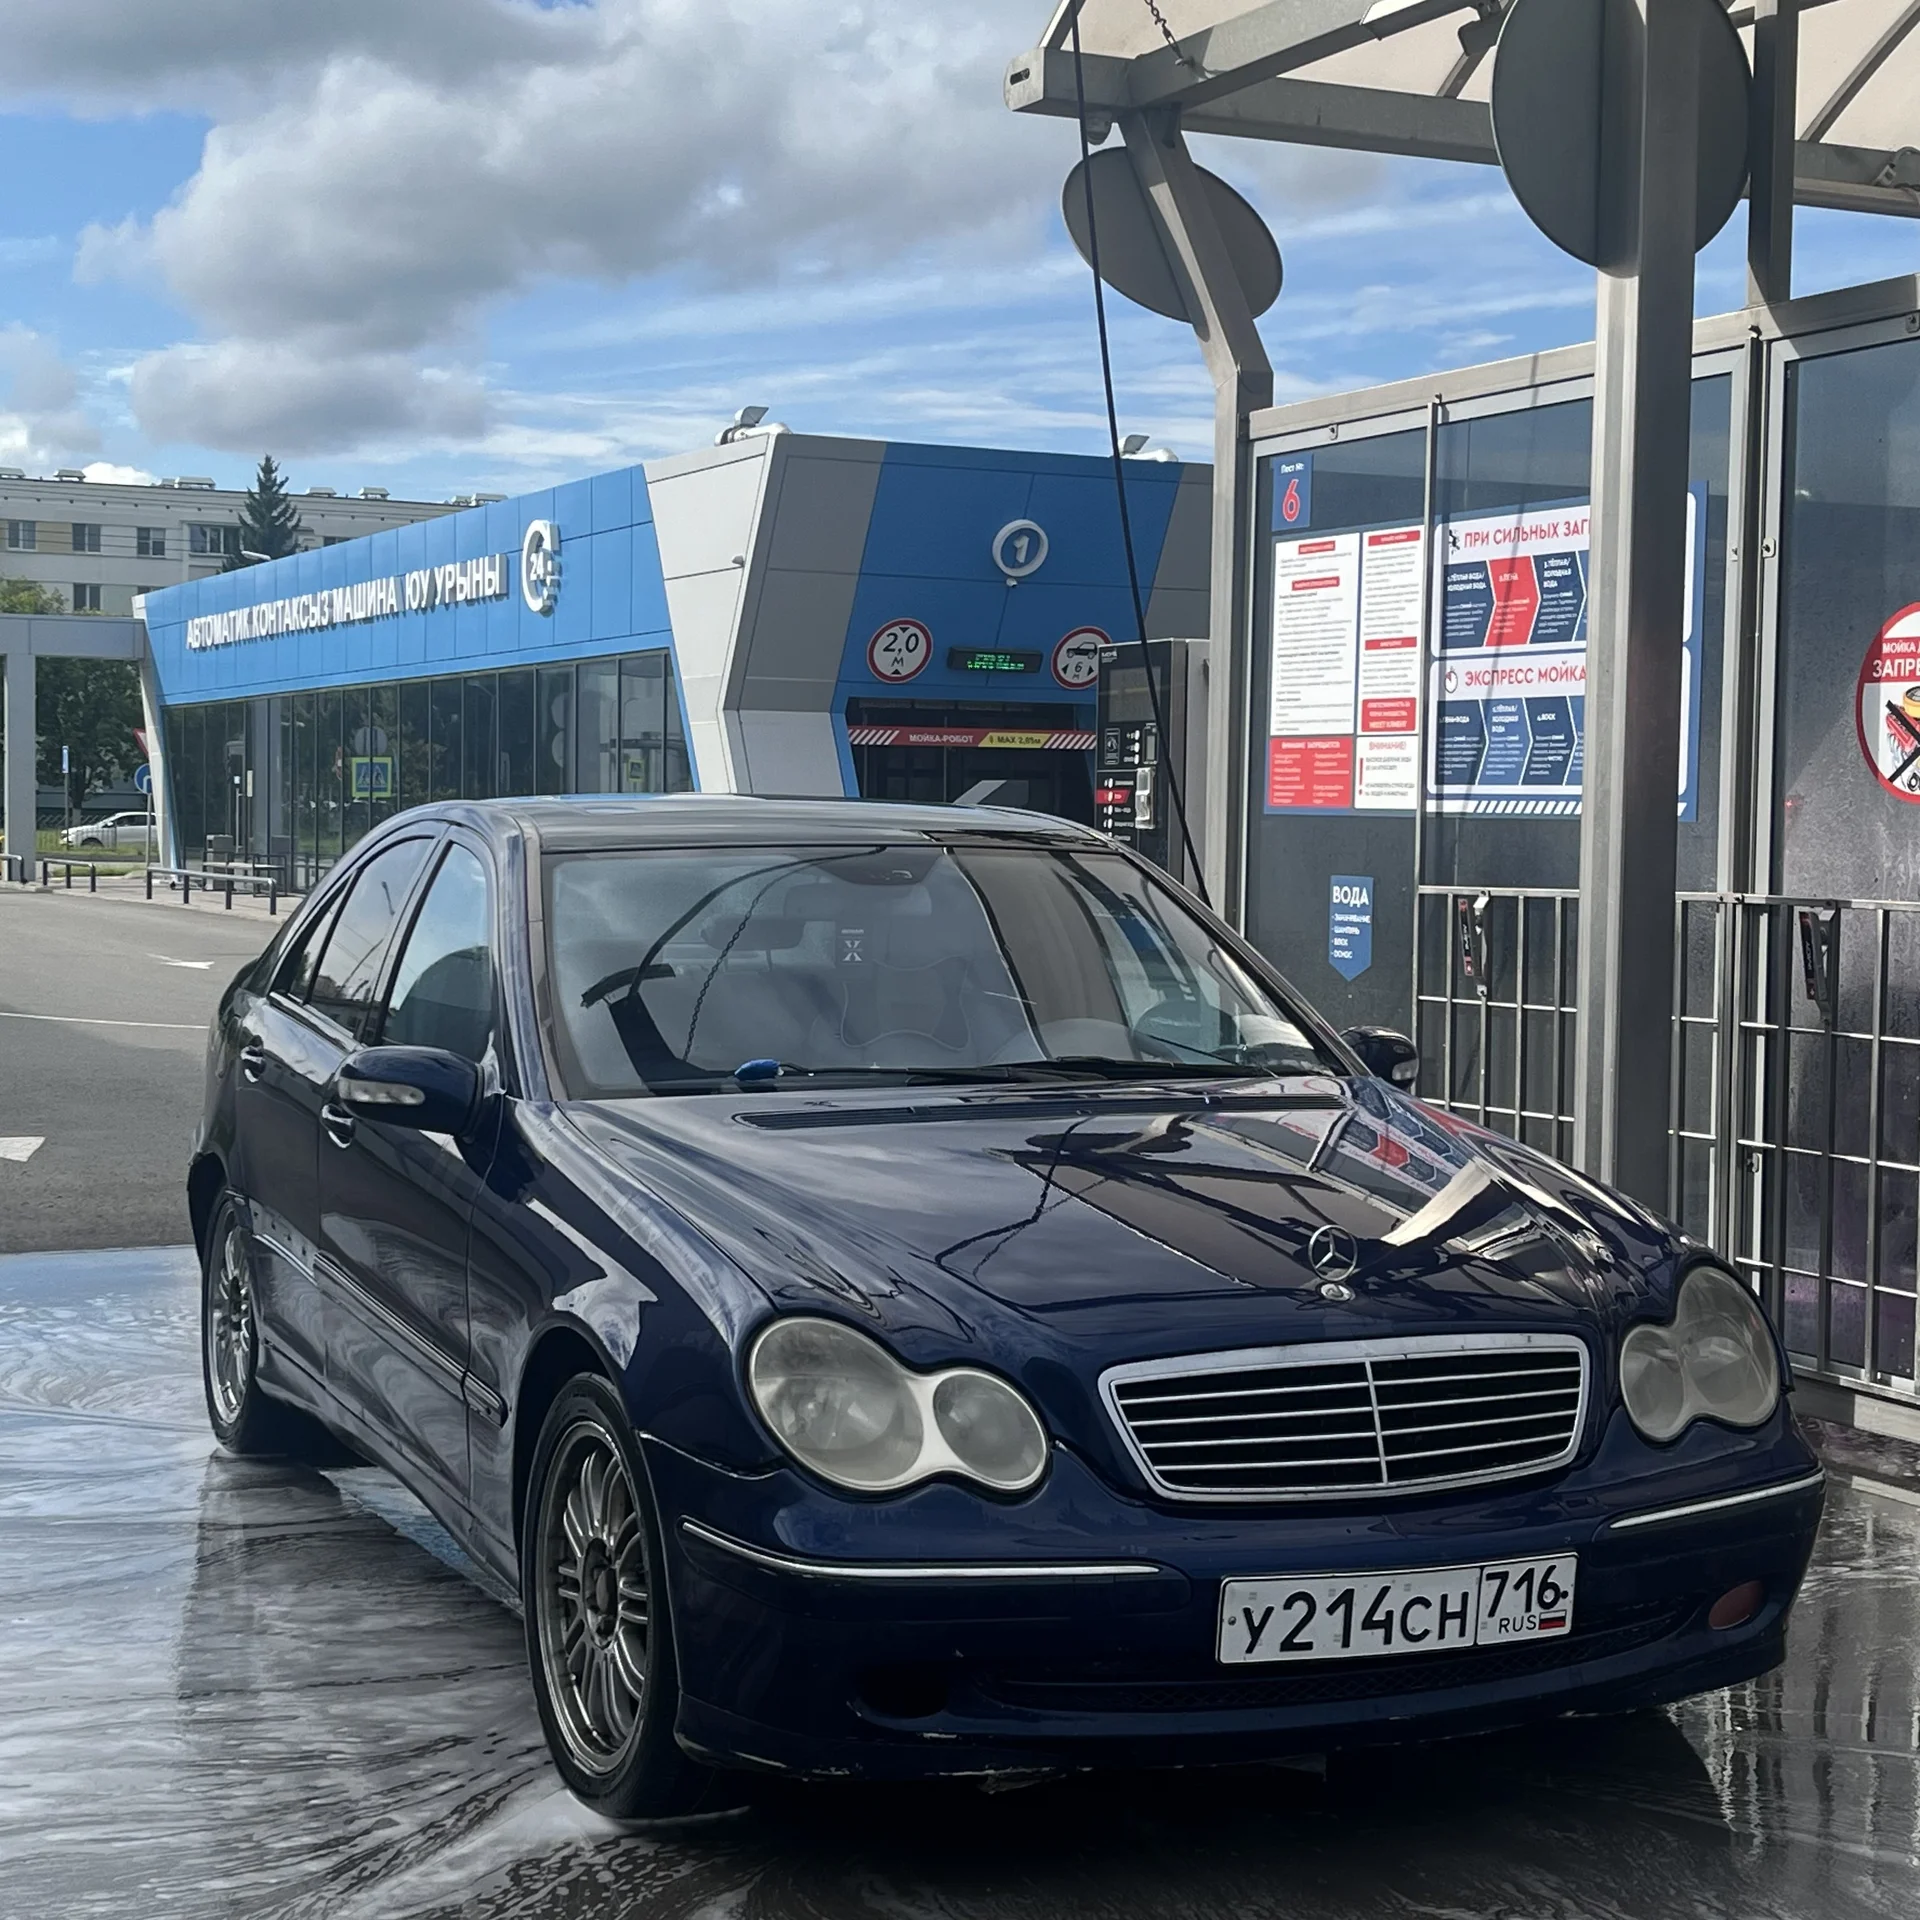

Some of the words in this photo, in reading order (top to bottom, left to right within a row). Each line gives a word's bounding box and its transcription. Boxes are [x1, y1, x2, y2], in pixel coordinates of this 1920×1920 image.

[1282, 478, 1300, 522] 6
[1464, 530, 1490, 548] ПРИ
[1493, 521, 1560, 546] СИЛЬНЫХ
[1563, 518, 1591, 537] ЗАГ
[1013, 535, 1030, 563] 1
[529, 552, 544, 581] 24
[186, 608, 250, 649] АВТОМАТИК
[251, 591, 329, 638] КОНТАКСЫЗ
[332, 576, 398, 623] МАШИНА
[405, 569, 431, 610] ЮУ
[434, 553, 501, 605] УРЫНЫ
[882, 633, 920, 655] 2,0
[1882, 639, 1917, 654] МОЙКА
[1073, 661, 1082, 673] 6
[1465, 667, 1534, 687] ЭКСПРЕСС
[1538, 660, 1587, 684] МОЙКА
[908, 732, 974, 744] МОЙКА-РОБОТ
[1332, 885, 1370, 908] ВОДА
[1485, 1565, 1561, 1618] 716
[1498, 1615, 1538, 1634] RUS
